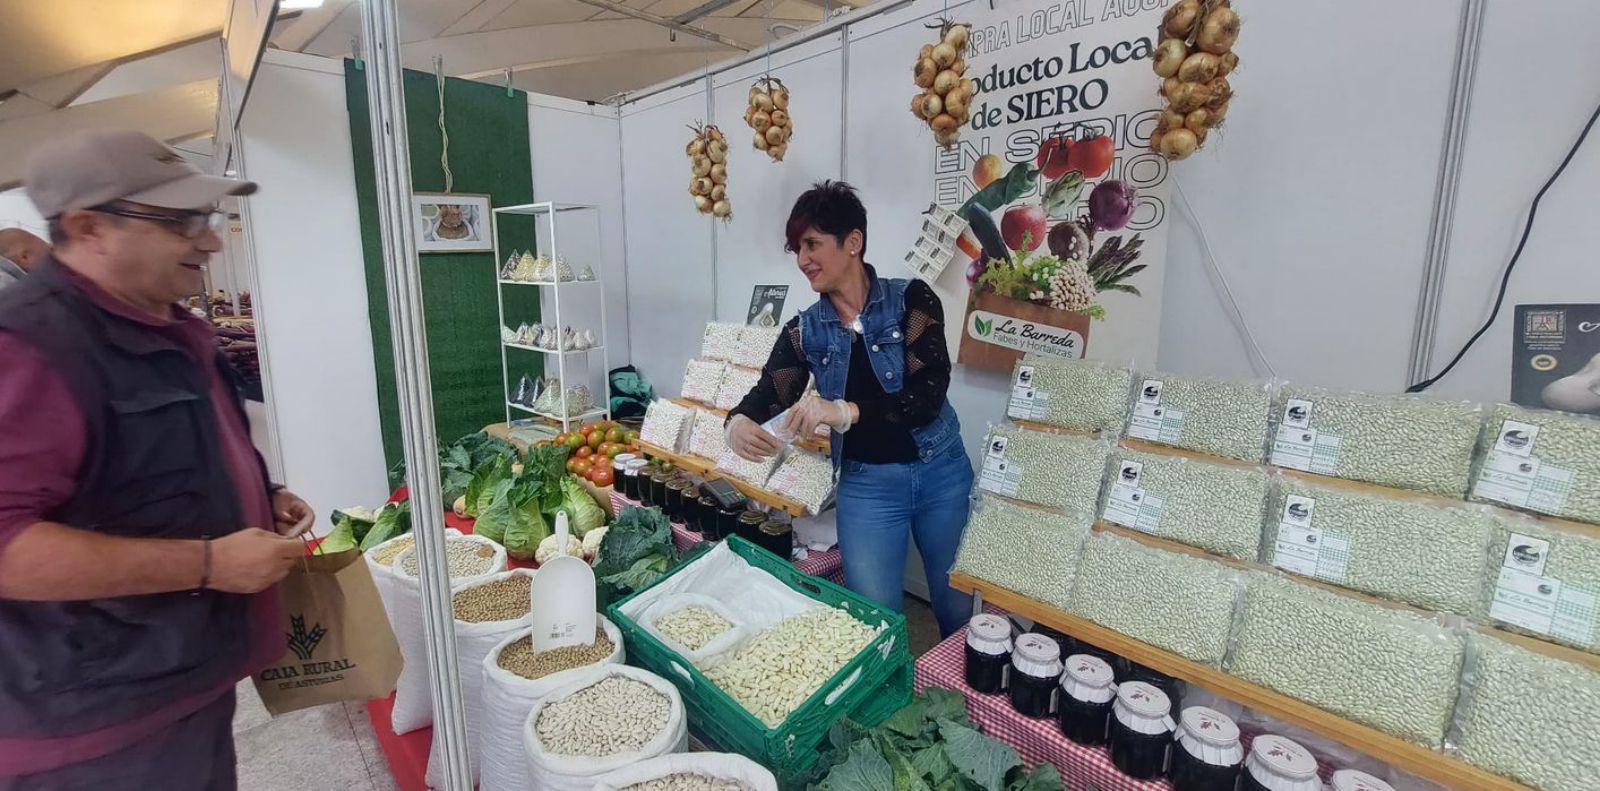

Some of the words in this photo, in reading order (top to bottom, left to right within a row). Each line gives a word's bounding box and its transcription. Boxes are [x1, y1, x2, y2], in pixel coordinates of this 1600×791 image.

[968, 20, 1011, 58] PRA
[1016, 0, 1094, 44] LOCAL
[971, 57, 1063, 96] oducto
[971, 103, 1001, 131] de
[1007, 78, 1108, 124] SIERO
[935, 136, 990, 174] EN
[993, 333, 1018, 346] Fabes
[1027, 341, 1073, 359] Hortalizas
[995, 320, 1017, 336] La
[1021, 324, 1074, 348] Barreda
[303, 659, 356, 676] RURAL
